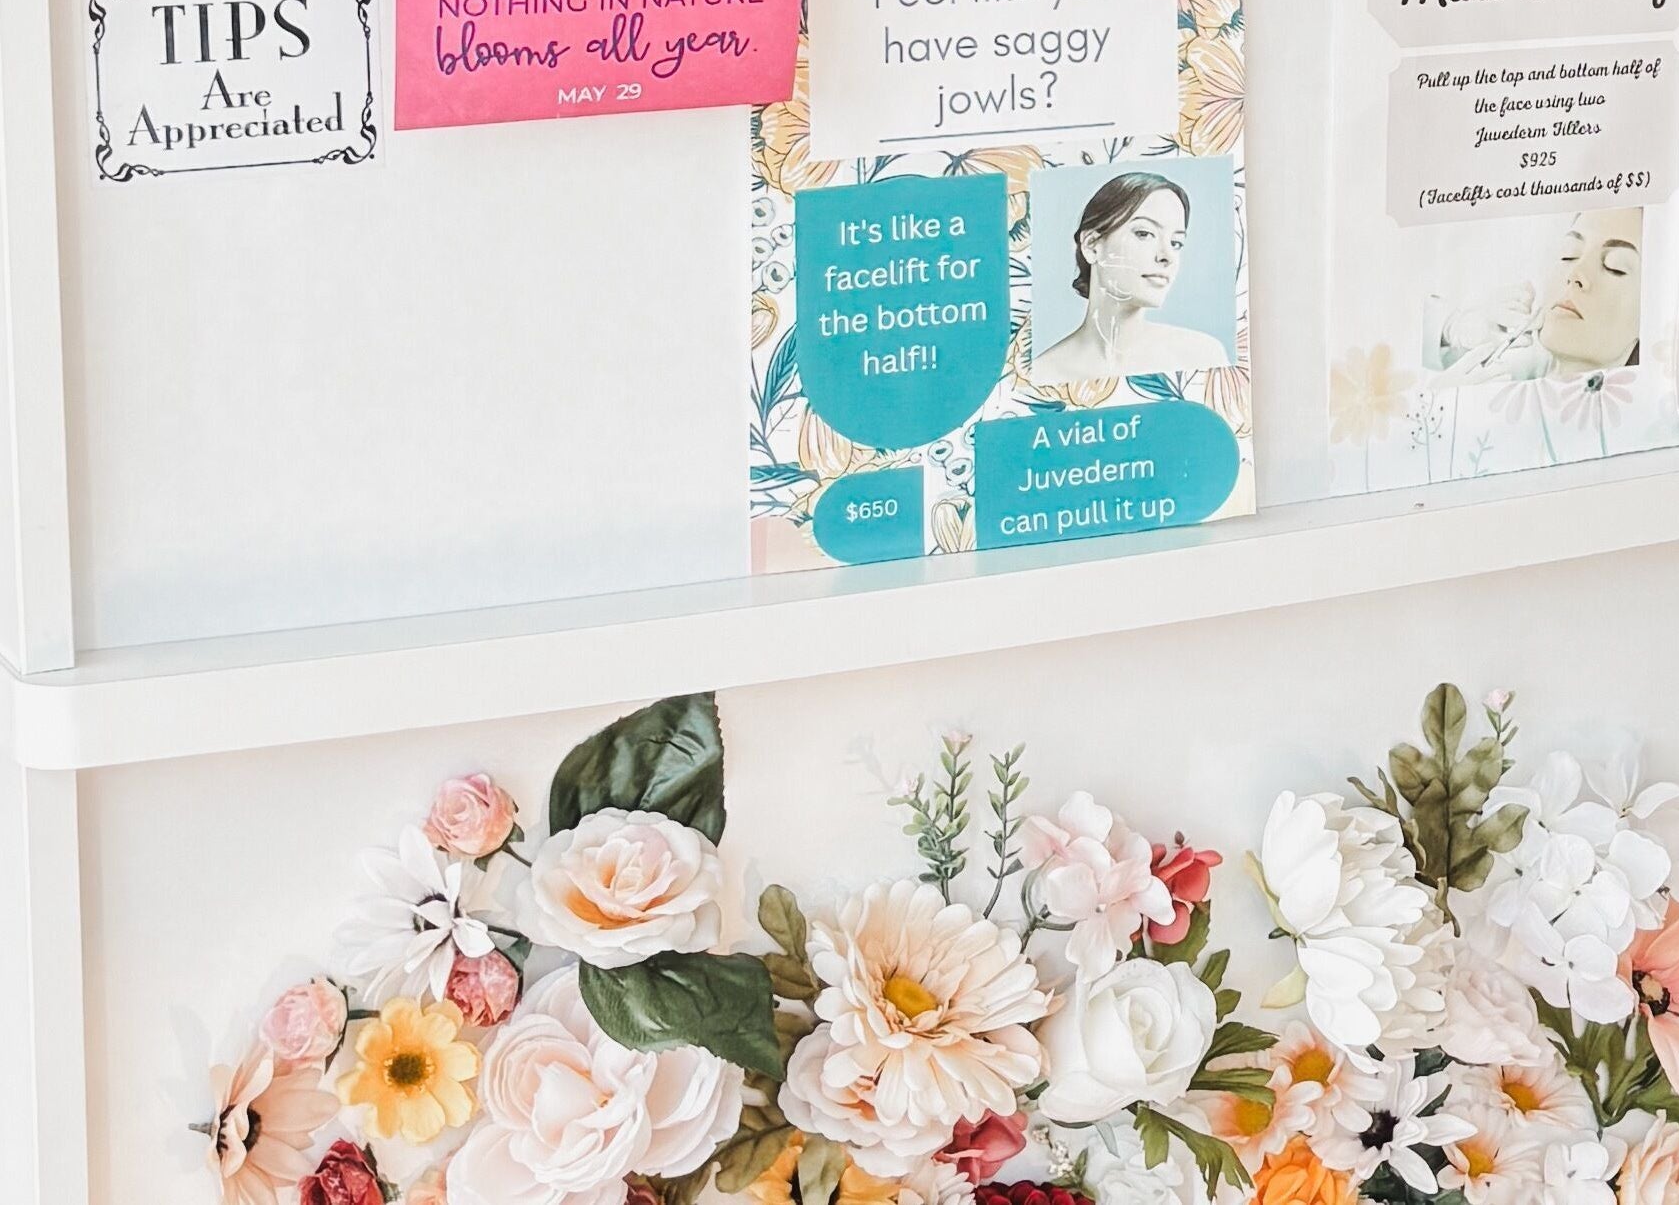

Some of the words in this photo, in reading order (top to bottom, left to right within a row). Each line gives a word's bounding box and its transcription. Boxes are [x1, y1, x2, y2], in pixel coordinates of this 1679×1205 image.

[435, 20, 571, 76] blooms
[586, 12, 651, 63] all
[651, 29, 759, 79] year.
[884, 26, 978, 64] have
[993, 27, 1111, 65] saggy
[200, 69, 272, 111] Are
[1417, 71, 1451, 89] Pull
[1452, 75, 1471, 91] up
[1474, 68, 1498, 85] the
[1500, 68, 1525, 87] top
[1528, 64, 1556, 81] and
[1559, 62, 1609, 79] bottom
[1612, 59, 1644, 79] half
[1645, 57, 1662, 79] of
[558, 85, 606, 105] MAY
[616, 83, 642, 101] 29
[934, 70, 1058, 127] jowls?
[1474, 98, 1497, 114] the
[1499, 96, 1533, 117] face
[1535, 94, 1575, 113] using
[1578, 91, 1606, 106] two
[126, 91, 345, 151] Appreciated
[1474, 123, 1547, 148] Juvederm
[1552, 119, 1602, 137] Fillers
[1519, 151, 1557, 169] $925
[1419, 184, 1492, 208] (Facelifts
[1496, 180, 1528, 199] cost
[1530, 175, 1602, 197] thousands
[1606, 173, 1624, 194] of
[839, 219, 883, 246] It's
[891, 213, 941, 241] like
[949, 215, 966, 236] a
[824, 257, 930, 292] facelift
[937, 254, 982, 281] for
[818, 309, 869, 337] the
[877, 301, 988, 331] bottom
[863, 345, 938, 376] half!!
[1032, 426, 1051, 450] A
[1058, 418, 1106, 447] vial
[1112, 414, 1142, 441] of
[1018, 459, 1155, 492] Juvederm
[845, 498, 899, 524] $650
[1000, 511, 1049, 535] can
[1057, 500, 1108, 535] pull
[1116, 497, 1134, 522] it
[1141, 497, 1176, 524] up
